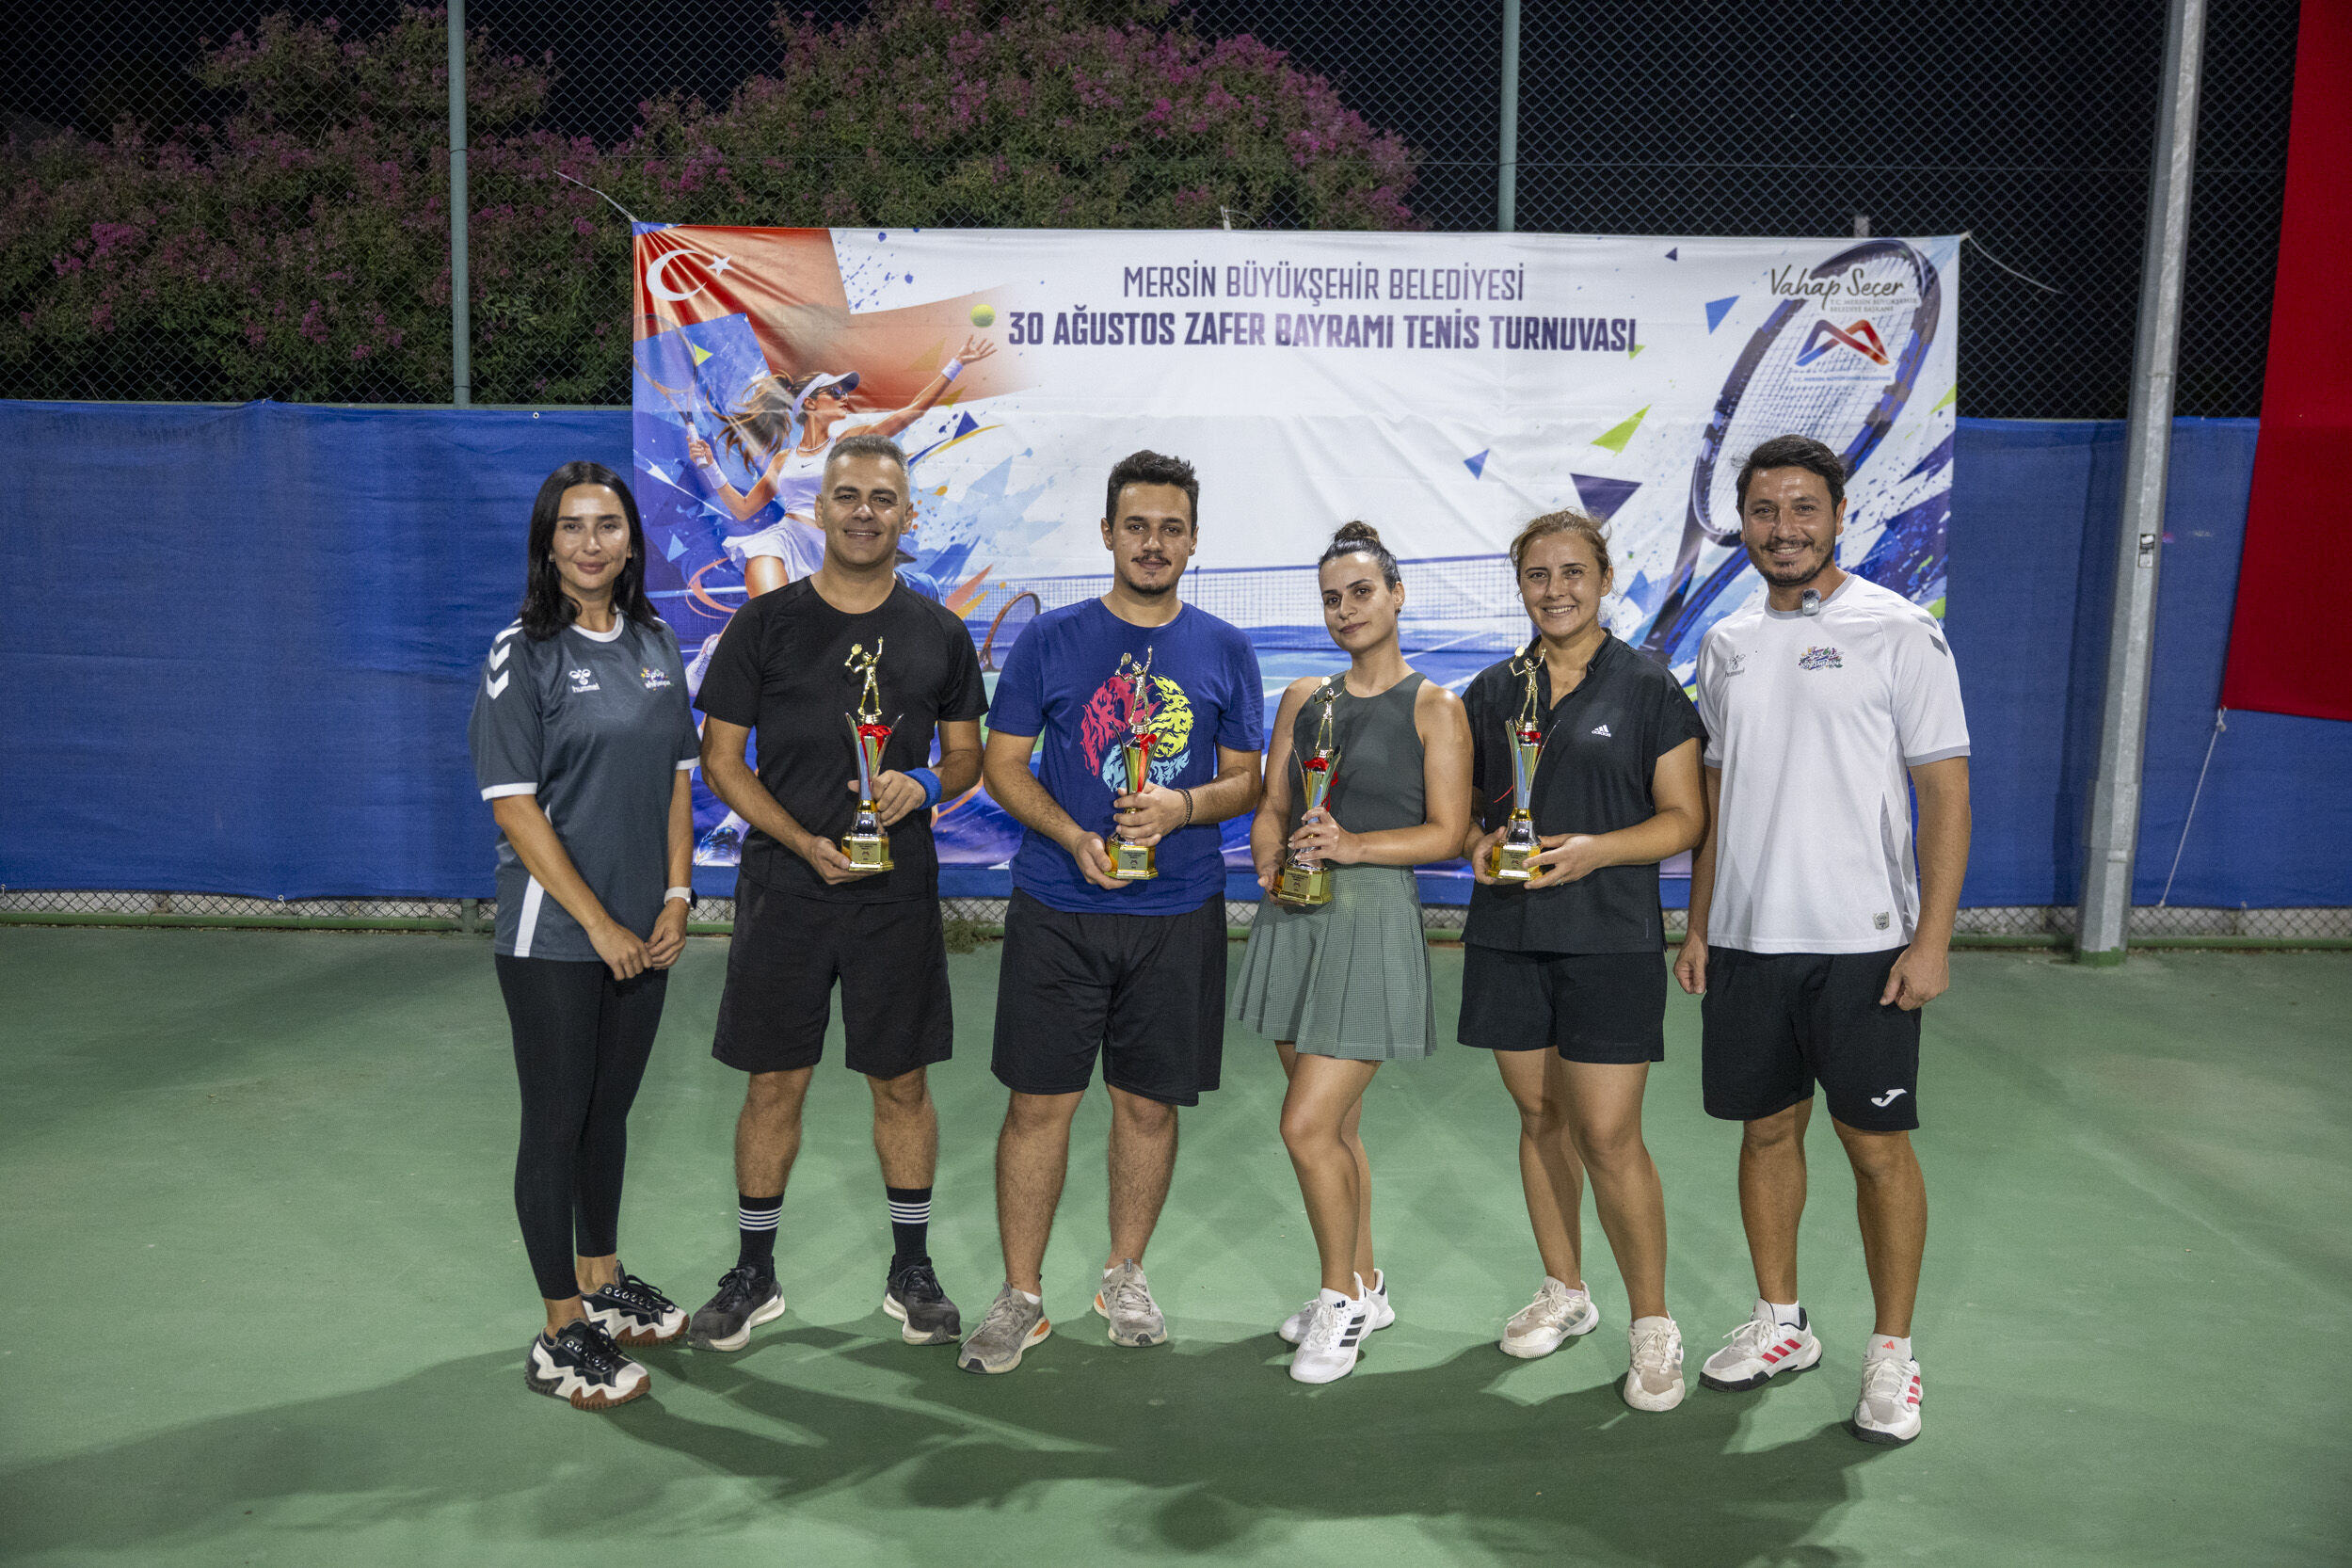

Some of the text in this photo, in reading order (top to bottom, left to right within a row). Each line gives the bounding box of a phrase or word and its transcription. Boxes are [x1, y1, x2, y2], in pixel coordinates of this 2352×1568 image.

[1124, 260, 1524, 307] MERSİN BÜYÜKŞEHİR BELEDİYESİ
[1770, 264, 1904, 311] Vahap Seçer
[1008, 304, 1637, 352] 30 AĞUSTOS ZAFER BAYRAMI TENİS TURNUVASI
